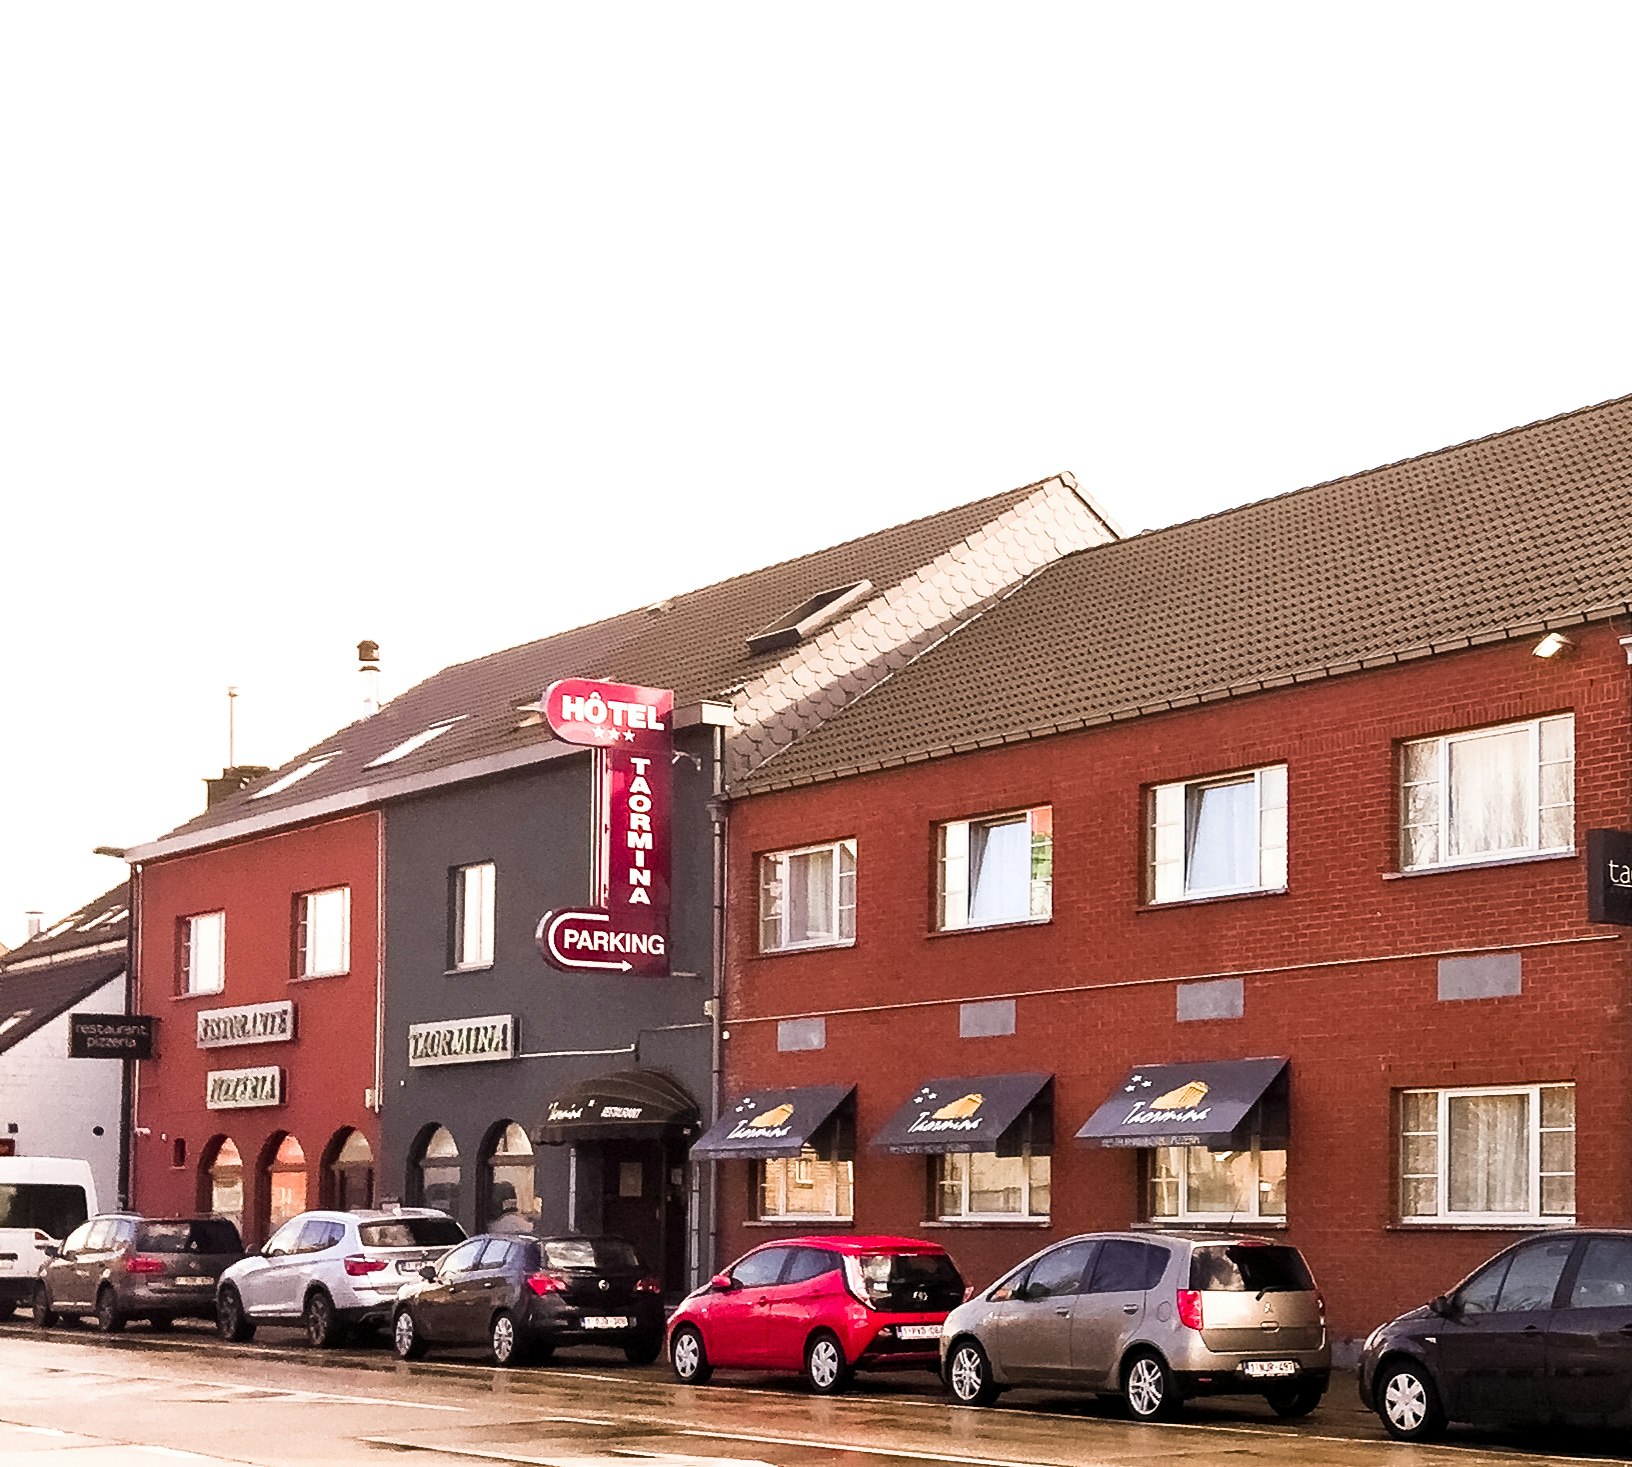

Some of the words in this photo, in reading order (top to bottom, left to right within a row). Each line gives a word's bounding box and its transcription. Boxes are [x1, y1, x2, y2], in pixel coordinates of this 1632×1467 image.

[562, 692, 664, 731] HÔTEL
[627, 757, 653, 905] TAORMINA
[563, 929, 665, 955] PARKING
[76, 1024, 149, 1036] restaurant
[408, 1023, 509, 1060] TAORMINA
[1122, 1101, 1212, 1125] Taormina
